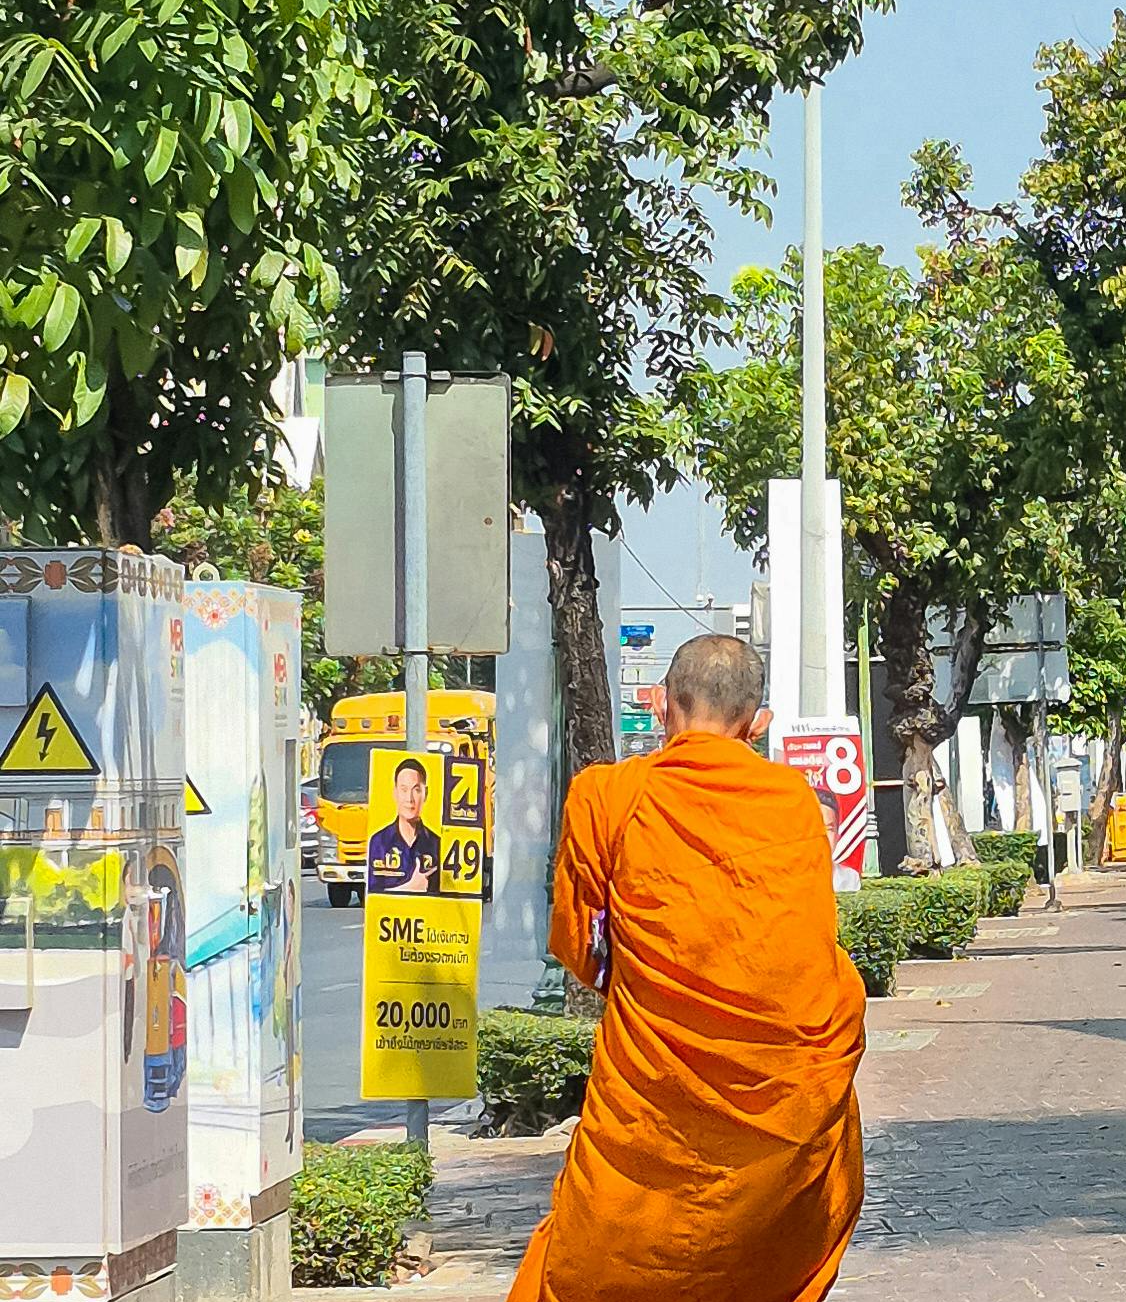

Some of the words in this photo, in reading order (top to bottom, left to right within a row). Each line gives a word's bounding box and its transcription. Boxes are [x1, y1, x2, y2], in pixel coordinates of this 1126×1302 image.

[825, 736, 862, 795] 8
[443, 839, 480, 880] 49
[379, 916, 424, 944] SME
[376, 1001, 451, 1033] 20,000
